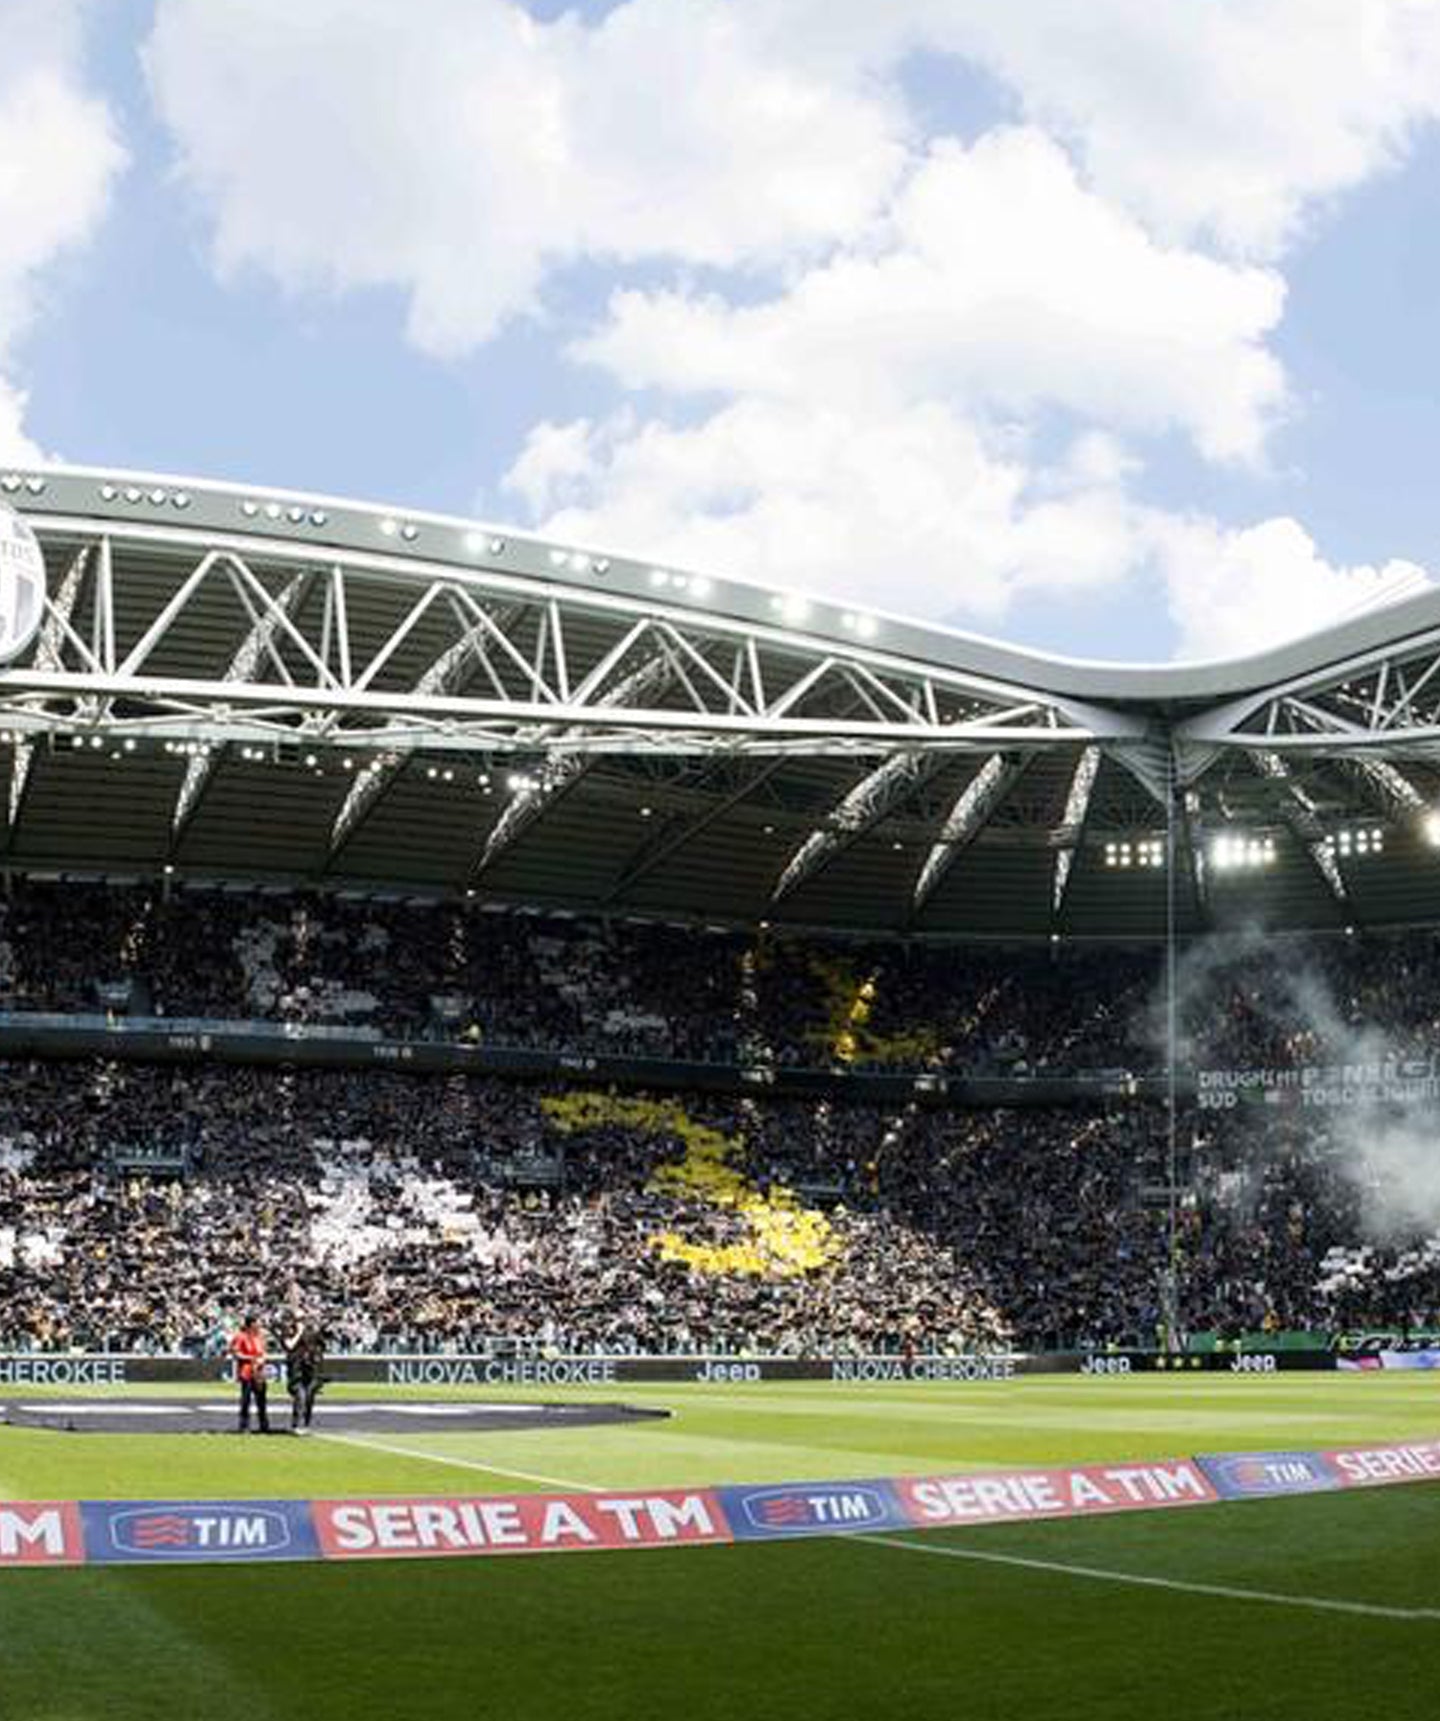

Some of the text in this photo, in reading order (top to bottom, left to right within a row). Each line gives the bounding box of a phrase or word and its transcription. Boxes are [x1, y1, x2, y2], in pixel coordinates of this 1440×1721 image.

[388, 1360, 617, 1384] NUOVA CHEROKEE
[697, 1361, 761, 1382] Jeep
[833, 1359, 1015, 1381] NUOVA CHEROKEE
[1081, 1355, 1131, 1375] Jeep
[1231, 1352, 1276, 1372] Jeep
[1265, 1462, 1312, 1484] TIM
[910, 1465, 1207, 1520] SERIE A TIM
[809, 1497, 872, 1521] TIM
[193, 1516, 268, 1546] TIM
[331, 1502, 527, 1549] SERIE
[541, 1501, 596, 1542] A
